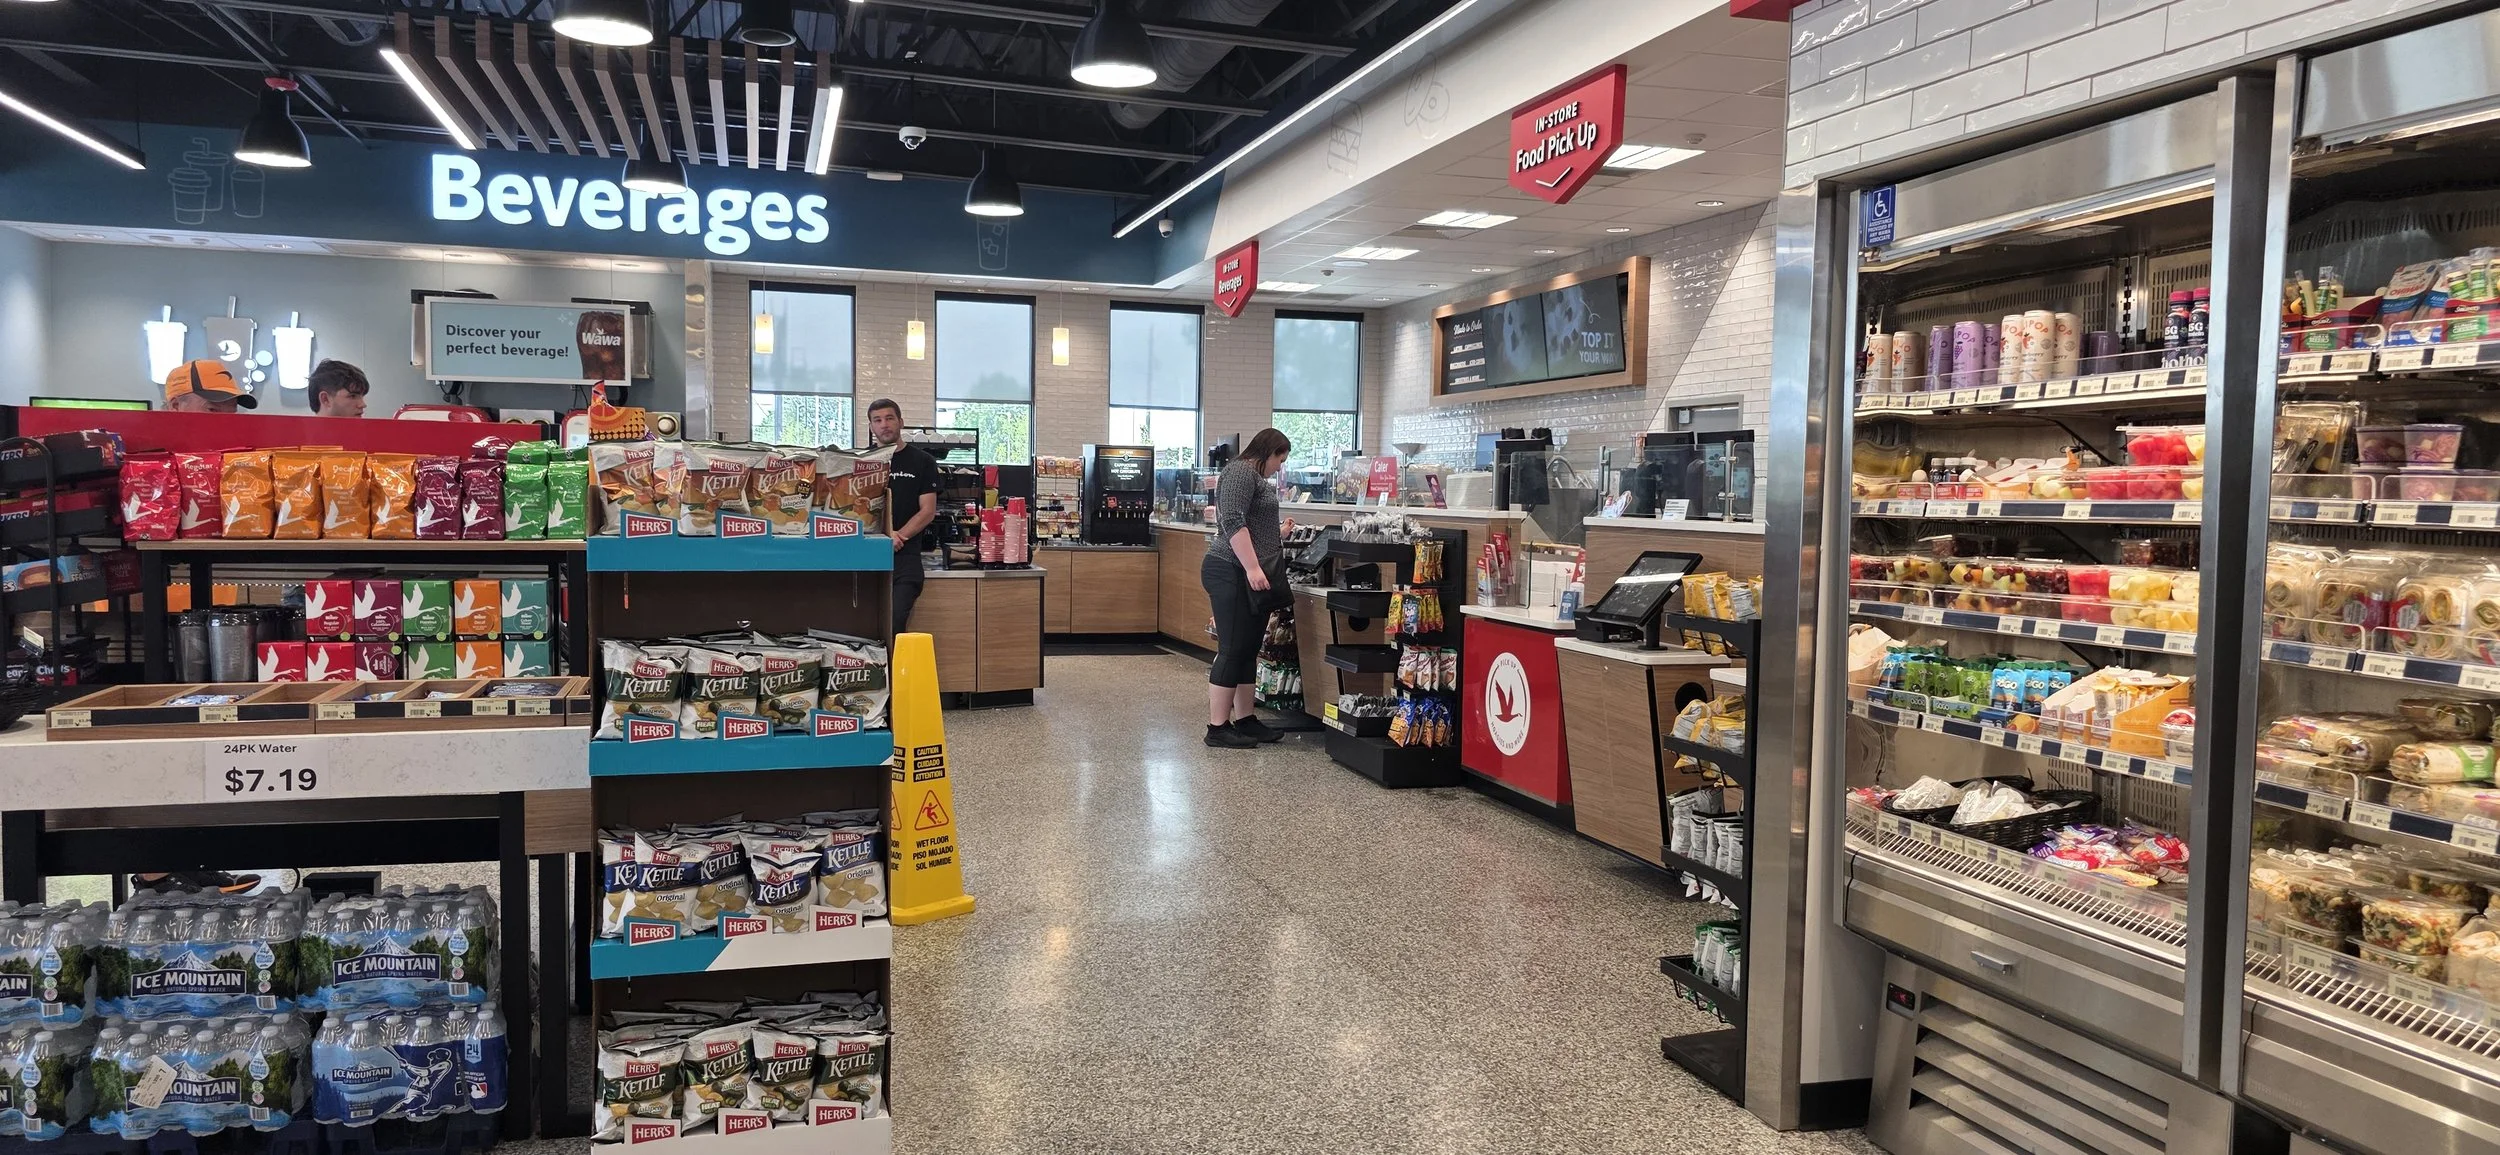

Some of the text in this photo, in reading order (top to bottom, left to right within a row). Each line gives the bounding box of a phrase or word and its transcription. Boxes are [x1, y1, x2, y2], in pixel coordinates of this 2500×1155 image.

[1535, 101, 1578, 133] IN-STORE
[1516, 121, 1597, 173] Food Pick Up
[431, 154, 831, 256] Beverages
[1869, 235, 1890, 243] ASSOCIATE
[1219, 275, 1242, 294] Beverages
[446, 324, 542, 341] Discover your
[2165, 326, 2178, 335] 5G
[2188, 322, 2203, 331] 5G
[582, 331, 622, 346] Wawa
[1581, 332, 1615, 348] TOP IT
[446, 342, 569, 359] perfect beverage!
[1579, 351, 1619, 365] YOUR WAY
[713, 461, 741, 471] HERR'S
[856, 462, 881, 471] HERR'S
[1374, 461, 1389, 472] Cater
[758, 468, 801, 493] KETTLE
[848, 471, 889, 496] KETTLE
[631, 520, 668, 533] HERR'S
[726, 520, 762, 533] HERR'S
[819, 521, 854, 533] HERR'S
[713, 663, 740, 674] HERR'S
[768, 660, 795, 670] HERR'S
[837, 657, 862, 667] HERR'S
[1500, 659, 1510, 667] PICK
[636, 664, 664, 677] HERR'S
[760, 669, 805, 696] KETTLE
[825, 669, 870, 691] KETTLE
[620, 677, 672, 699] KETTLE
[700, 676, 749, 699] KETTLE
[633, 724, 671, 738] HERR'S
[728, 721, 764, 735] HERR'S
[819, 719, 854, 731] HERR'S
[224, 743, 297, 754] 24PK Water
[916, 746, 939, 756] CAUTION
[1505, 742, 1514, 750] AND
[917, 758, 940, 768] CUIDADO
[225, 766, 318, 796] $7.19
[915, 770, 943, 781] ATTENTION
[835, 833, 861, 842] HERR'S
[916, 835, 949, 848] WET FLOOR
[827, 840, 871, 868] KETTLE
[912, 845, 954, 860] PISO MOJADO
[701, 851, 741, 880] KETTLE
[915, 856, 952, 871] SOL HUMIDE
[640, 867, 685, 888] KETTLE
[847, 867, 874, 880] Original
[717, 878, 744, 891] Original
[656, 893, 687, 902] Original
[758, 881, 801, 904] KETTLE
[775, 903, 804, 914] Original
[819, 913, 854, 926] HERR'S
[633, 926, 671, 939] HERR'S
[728, 920, 763, 933] HERR'S
[337, 957, 437, 976] ICE MOUNTAIN
[136, 971, 242, 990] ICE MOUNTAIN
[467, 1043, 480, 1056] 24
[709, 1042, 736, 1054] HERR'S
[777, 1045, 804, 1055] HERR'S
[841, 1043, 866, 1052] HERR'S
[628, 1063, 656, 1074] HERR'S
[702, 1050, 748, 1079] KETTLE
[765, 1056, 813, 1083] KETTLE
[829, 1053, 875, 1078] KETTLE
[333, 1066, 391, 1080] ICE MOUNTAIN
[618, 1073, 667, 1100] KETTLE
[819, 1107, 853, 1120] HERR'S
[728, 1117, 764, 1130] HERR'S
[635, 1126, 672, 1139] HERR'S
